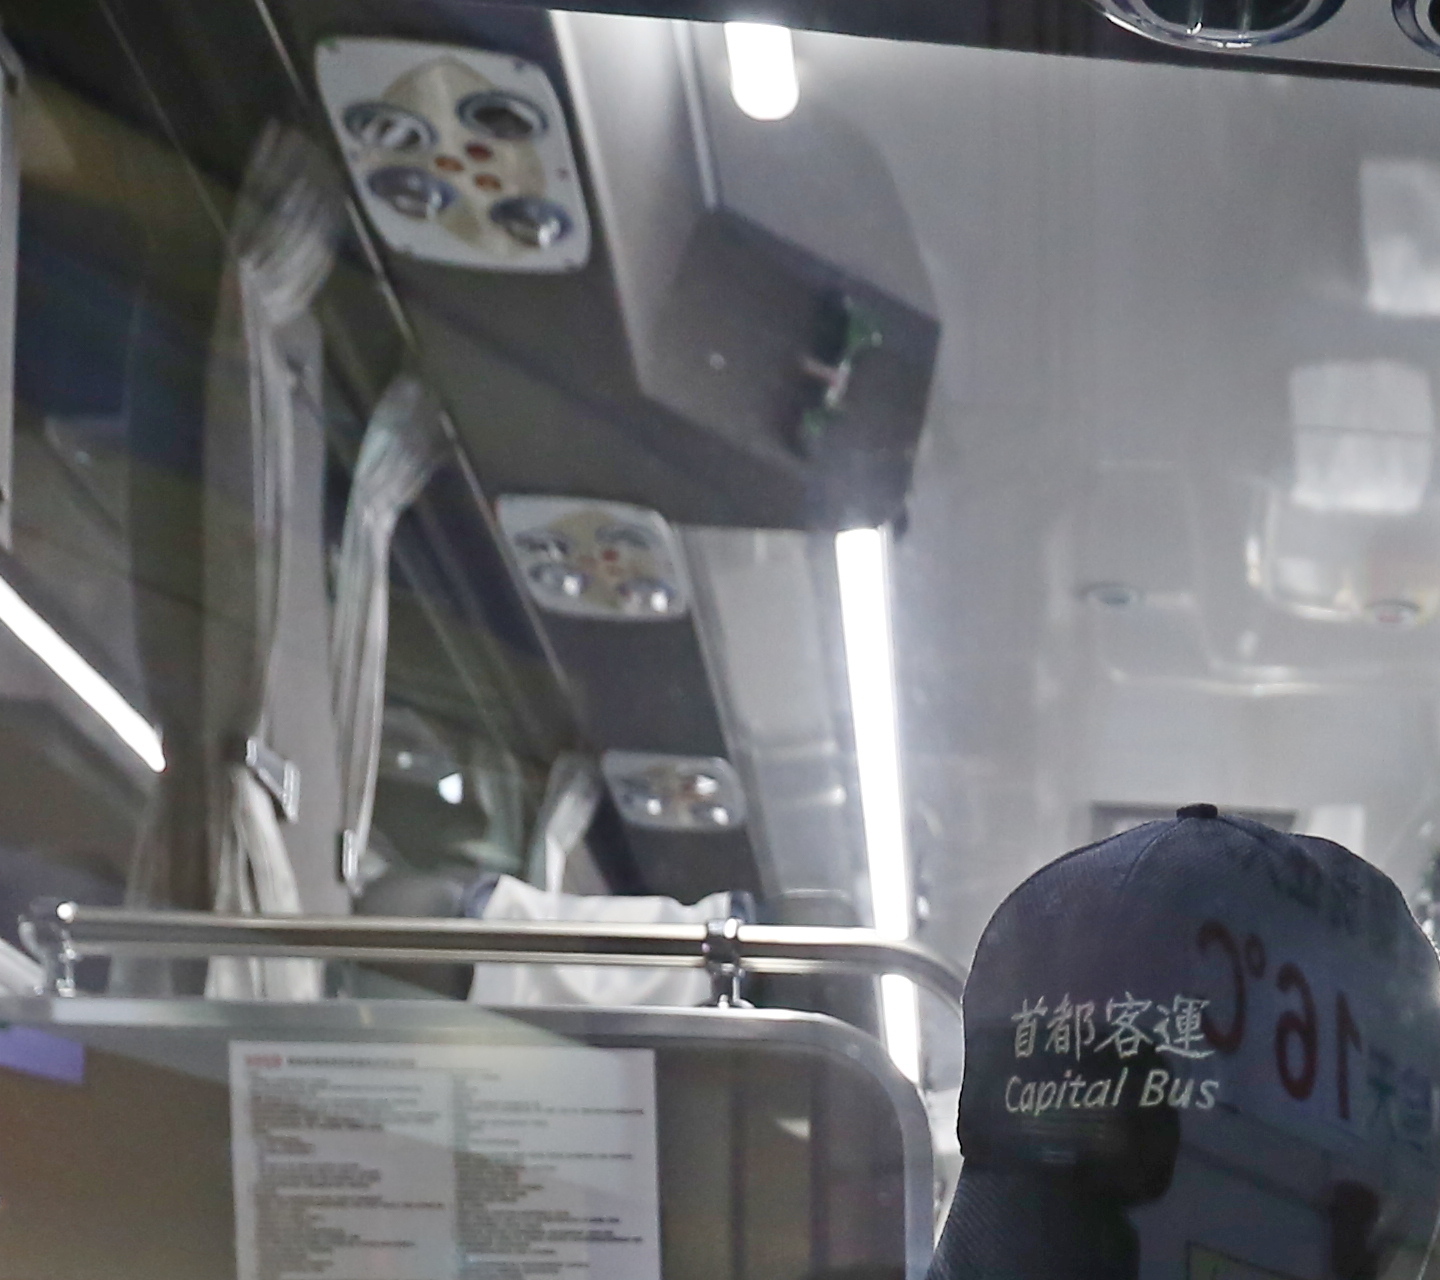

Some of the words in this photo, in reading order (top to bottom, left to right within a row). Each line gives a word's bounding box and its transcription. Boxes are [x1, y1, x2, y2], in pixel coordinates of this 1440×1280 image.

[1011, 992, 1216, 1062] 首都客運
[1005, 1068, 1127, 1115] Capital
[1140, 1067, 1220, 1109] Bus
